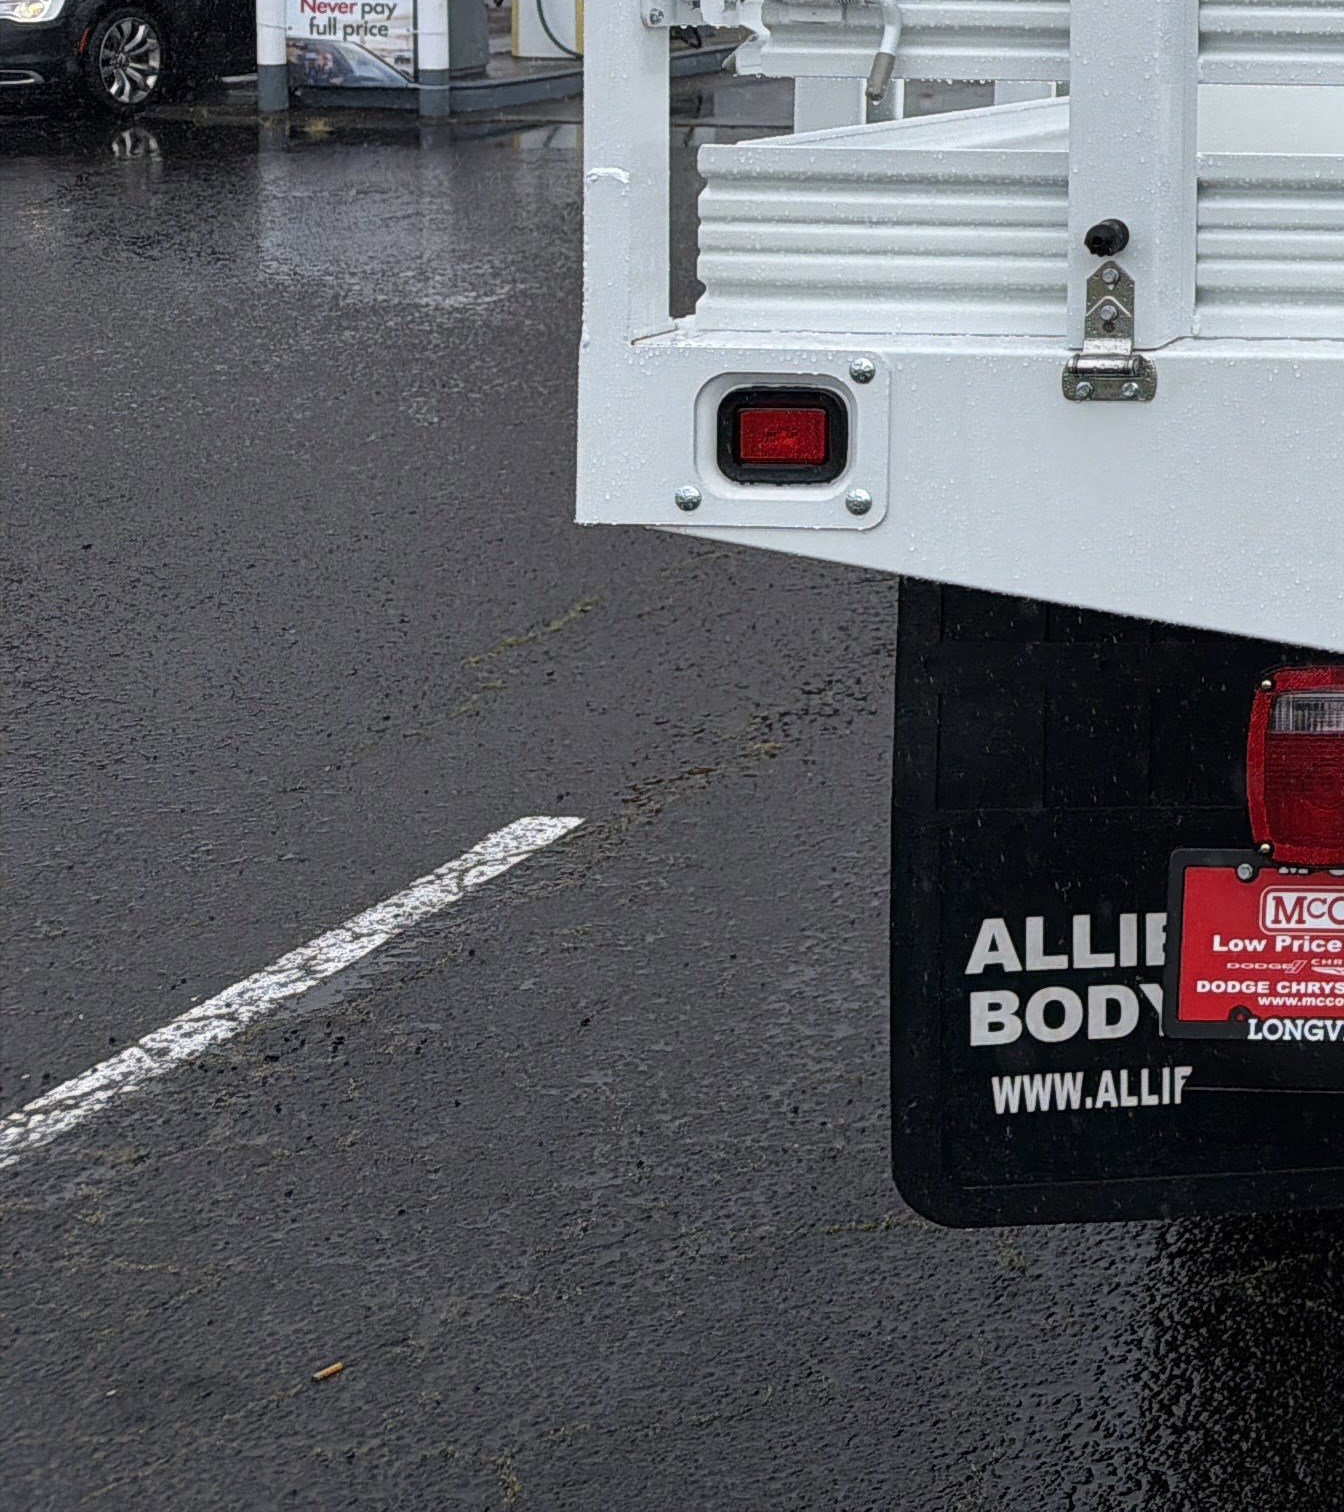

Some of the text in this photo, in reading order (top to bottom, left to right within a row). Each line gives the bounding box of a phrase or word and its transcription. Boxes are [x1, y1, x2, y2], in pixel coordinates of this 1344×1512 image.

[361, 2, 398, 21] pay
[309, 16, 389, 42] full price
[1213, 935, 1267, 953] Low
[1275, 935, 1342, 954] Price
[1226, 961, 1297, 971] DODGE
[1196, 980, 1270, 994] DODGE
